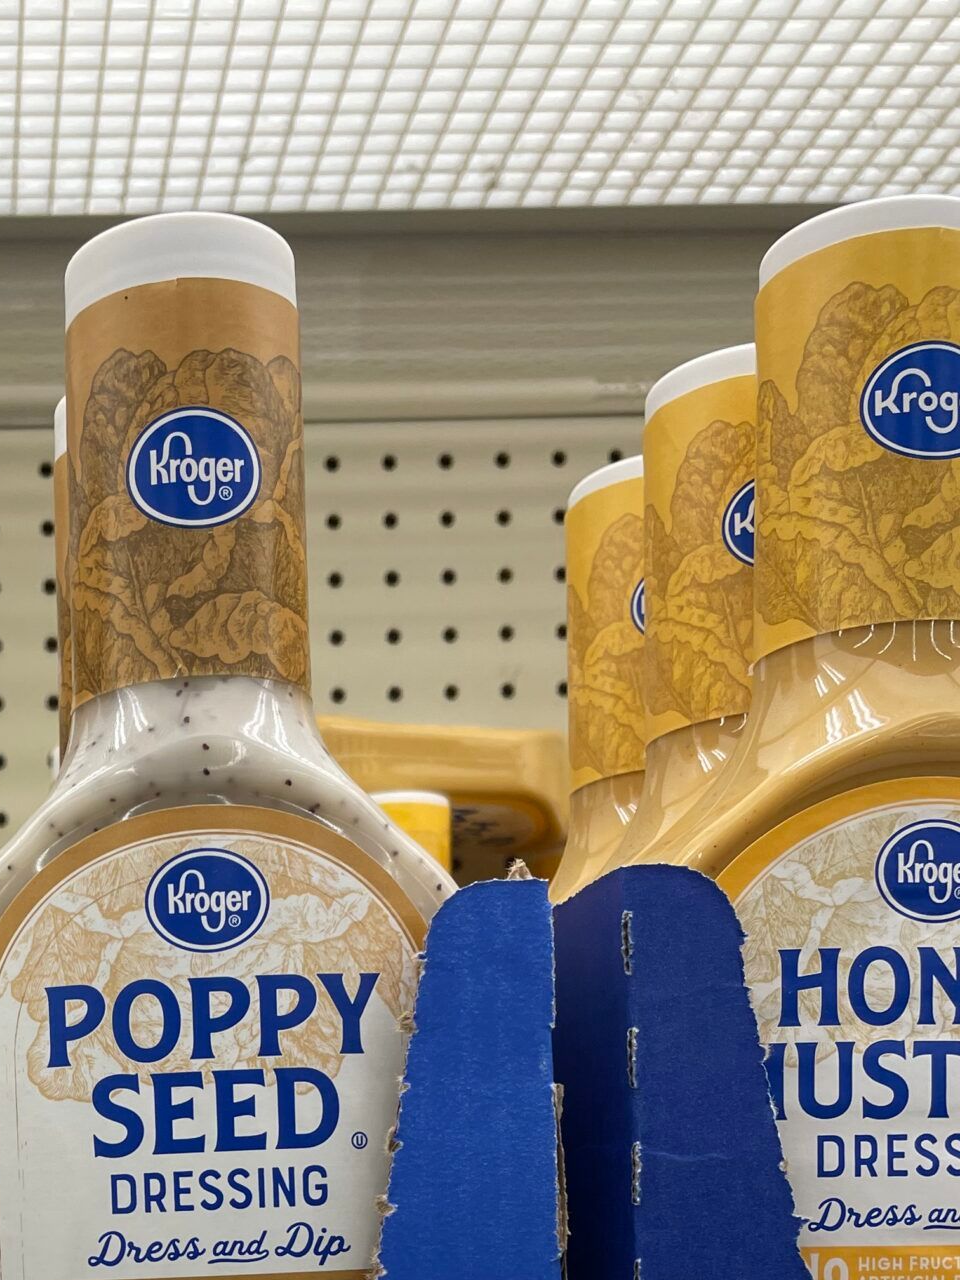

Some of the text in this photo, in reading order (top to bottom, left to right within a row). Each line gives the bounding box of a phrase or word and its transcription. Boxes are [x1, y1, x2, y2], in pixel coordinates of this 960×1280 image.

[874, 367, 960, 434] Krog
[149, 431, 245, 505] Kroger
[167, 868, 252, 933] Kroger
[777, 945, 960, 1027] HON
[44, 972, 381, 1068] POPPY
[91, 1066, 340, 1159] SEED
[816, 1132, 960, 1178] DRESS
[110, 1164, 330, 1215] DRESSING
[807, 1197, 960, 1232] Dress an
[87, 1221, 351, 1267] Dress and Dip
[858, 1255, 960, 1272] HIGH FRUCT
